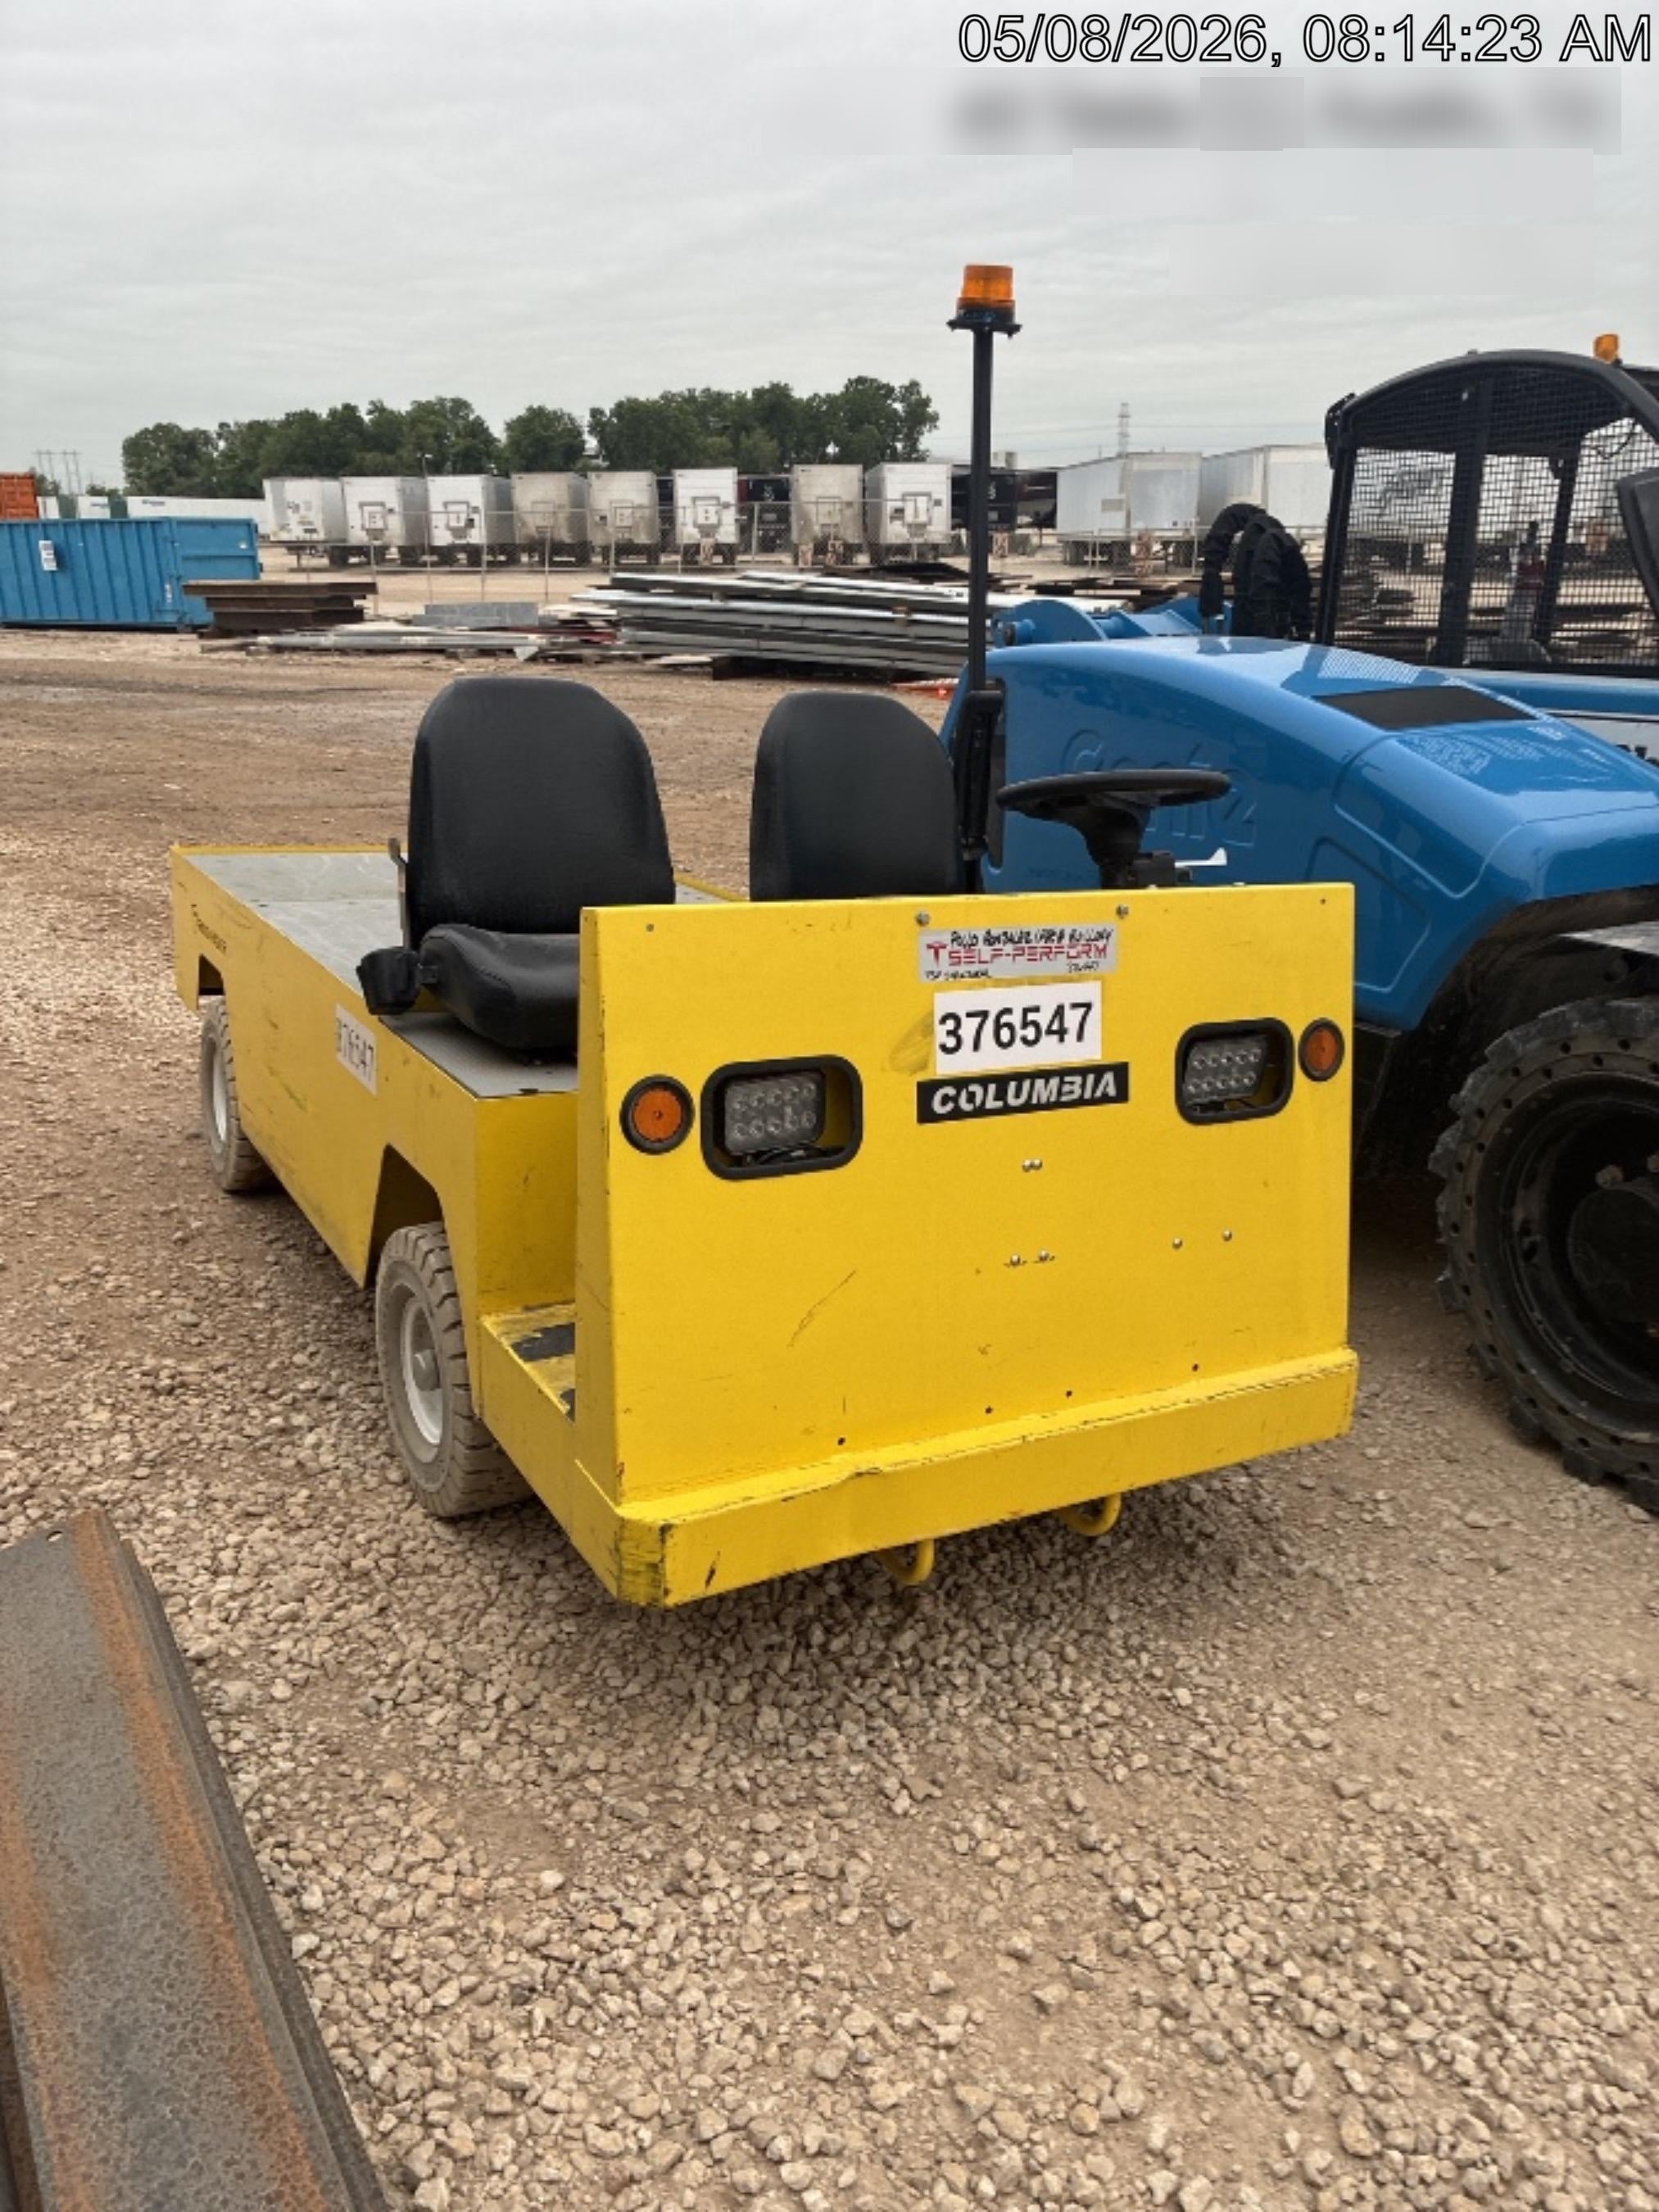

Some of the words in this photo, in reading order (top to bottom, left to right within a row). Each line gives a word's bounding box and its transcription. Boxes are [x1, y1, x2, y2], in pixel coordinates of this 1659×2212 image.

[948, 943, 1107, 967] SELF-PERFORM
[938, 1002, 1093, 1055] 376547
[931, 1071, 1117, 1115] COLUMBIA
